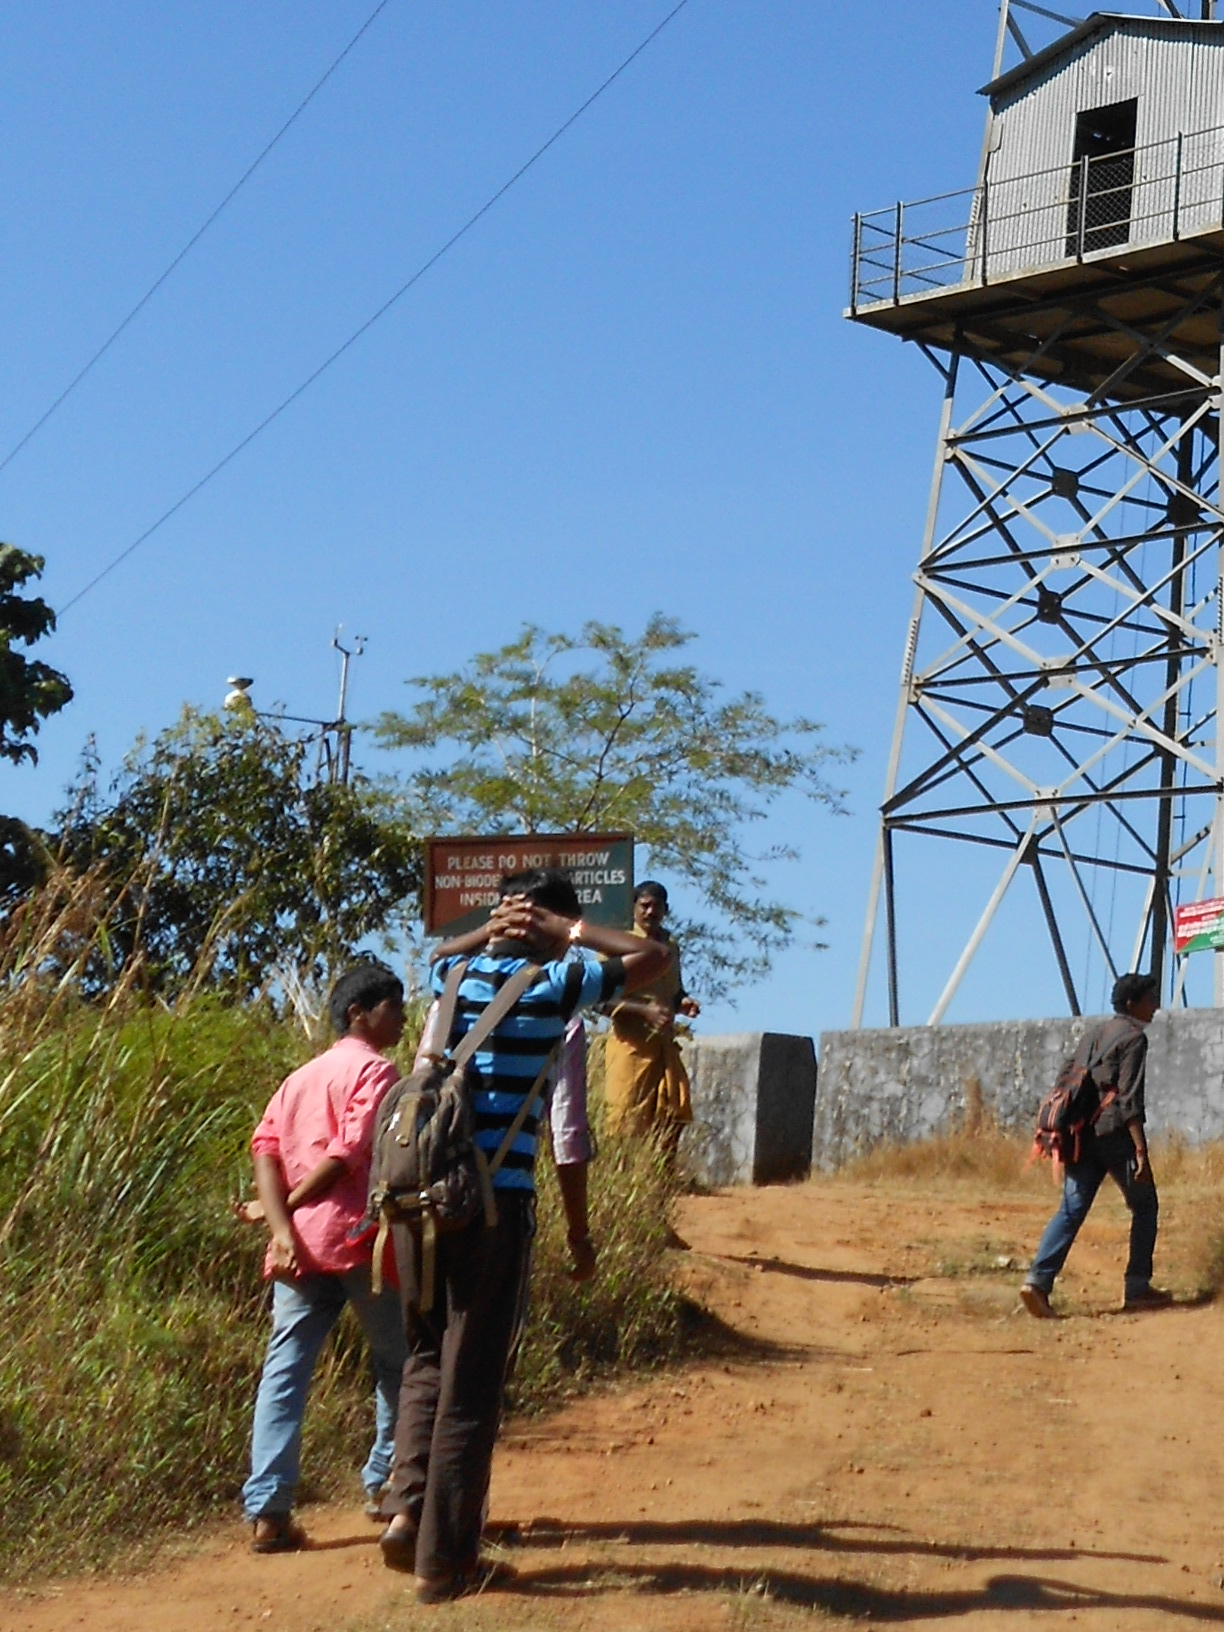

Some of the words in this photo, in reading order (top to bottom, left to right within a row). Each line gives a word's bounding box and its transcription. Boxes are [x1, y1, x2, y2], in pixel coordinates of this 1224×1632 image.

[447, 855, 494, 870] PLEASE
[498, 854, 516, 869] DO
[522, 853, 552, 868] NOT
[558, 851, 610, 867] THROW
[435, 874, 504, 889] NON-BIODE
[574, 889, 603, 904] REA
